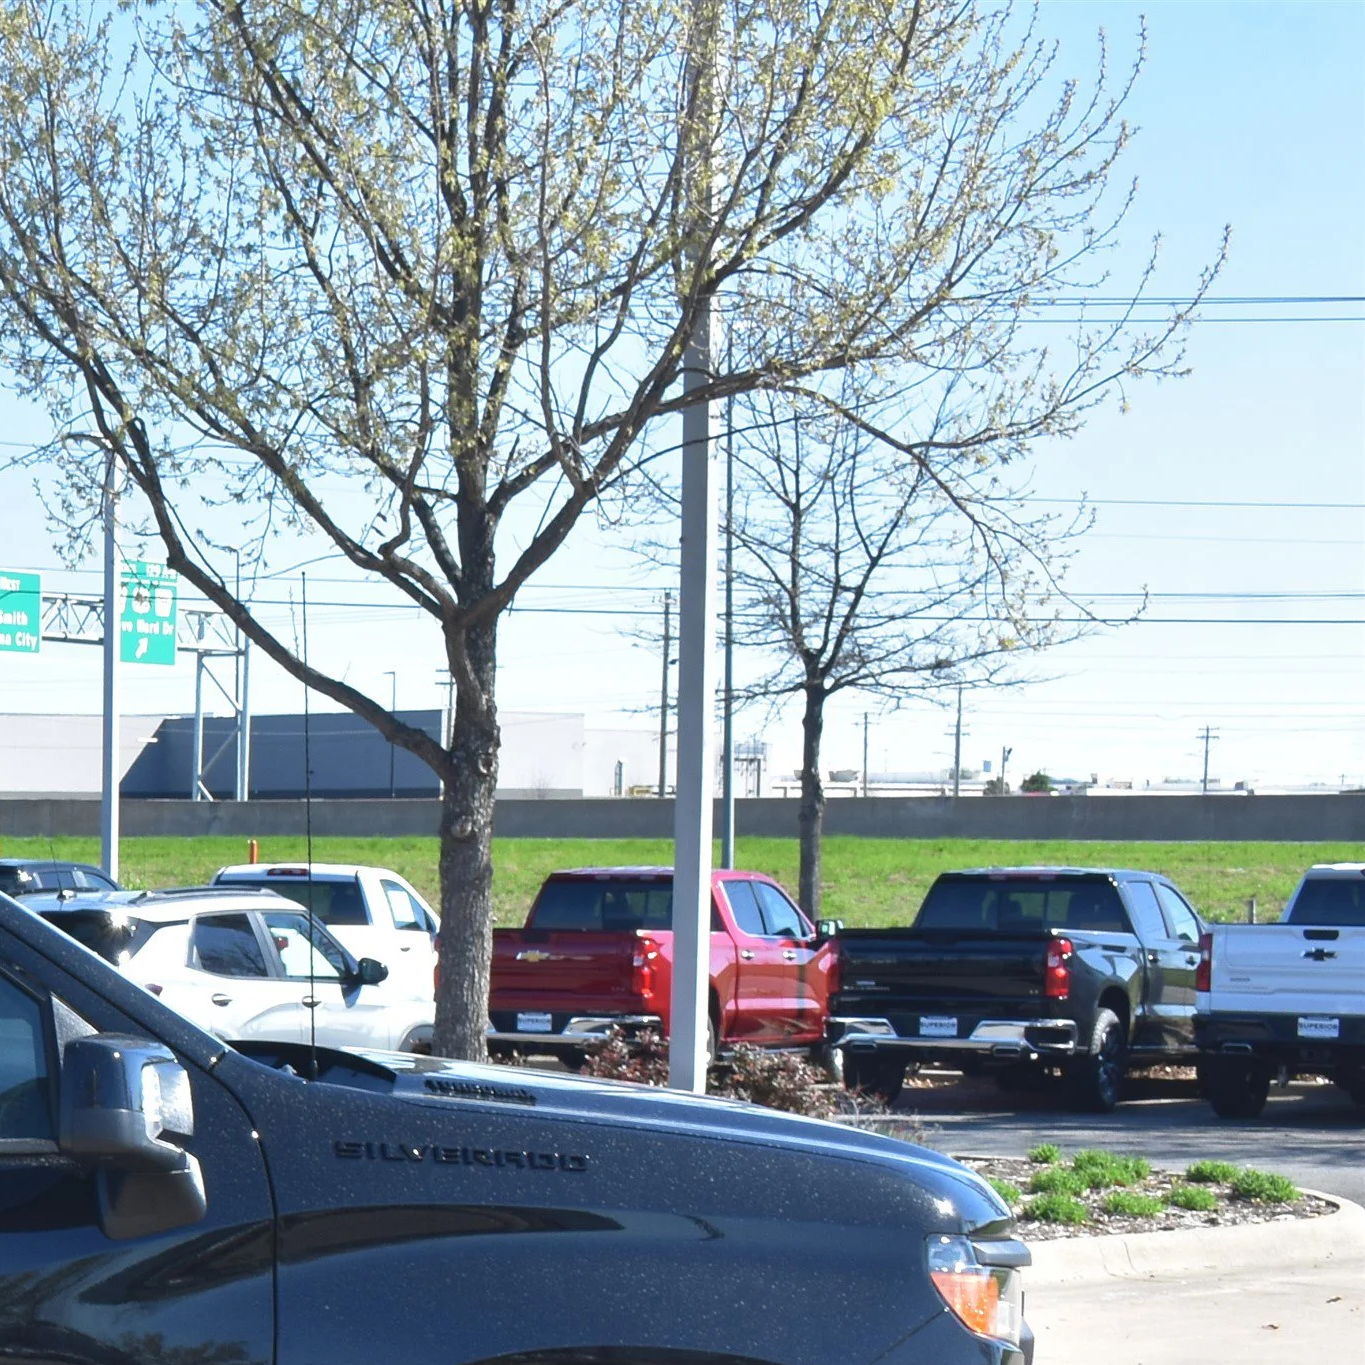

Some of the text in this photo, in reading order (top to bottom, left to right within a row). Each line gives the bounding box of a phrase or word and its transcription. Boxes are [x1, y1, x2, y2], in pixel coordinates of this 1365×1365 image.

[162, 621, 174, 636] Dr
[15, 631, 38, 651] City
[333, 1140, 589, 1172] SILVERADO
